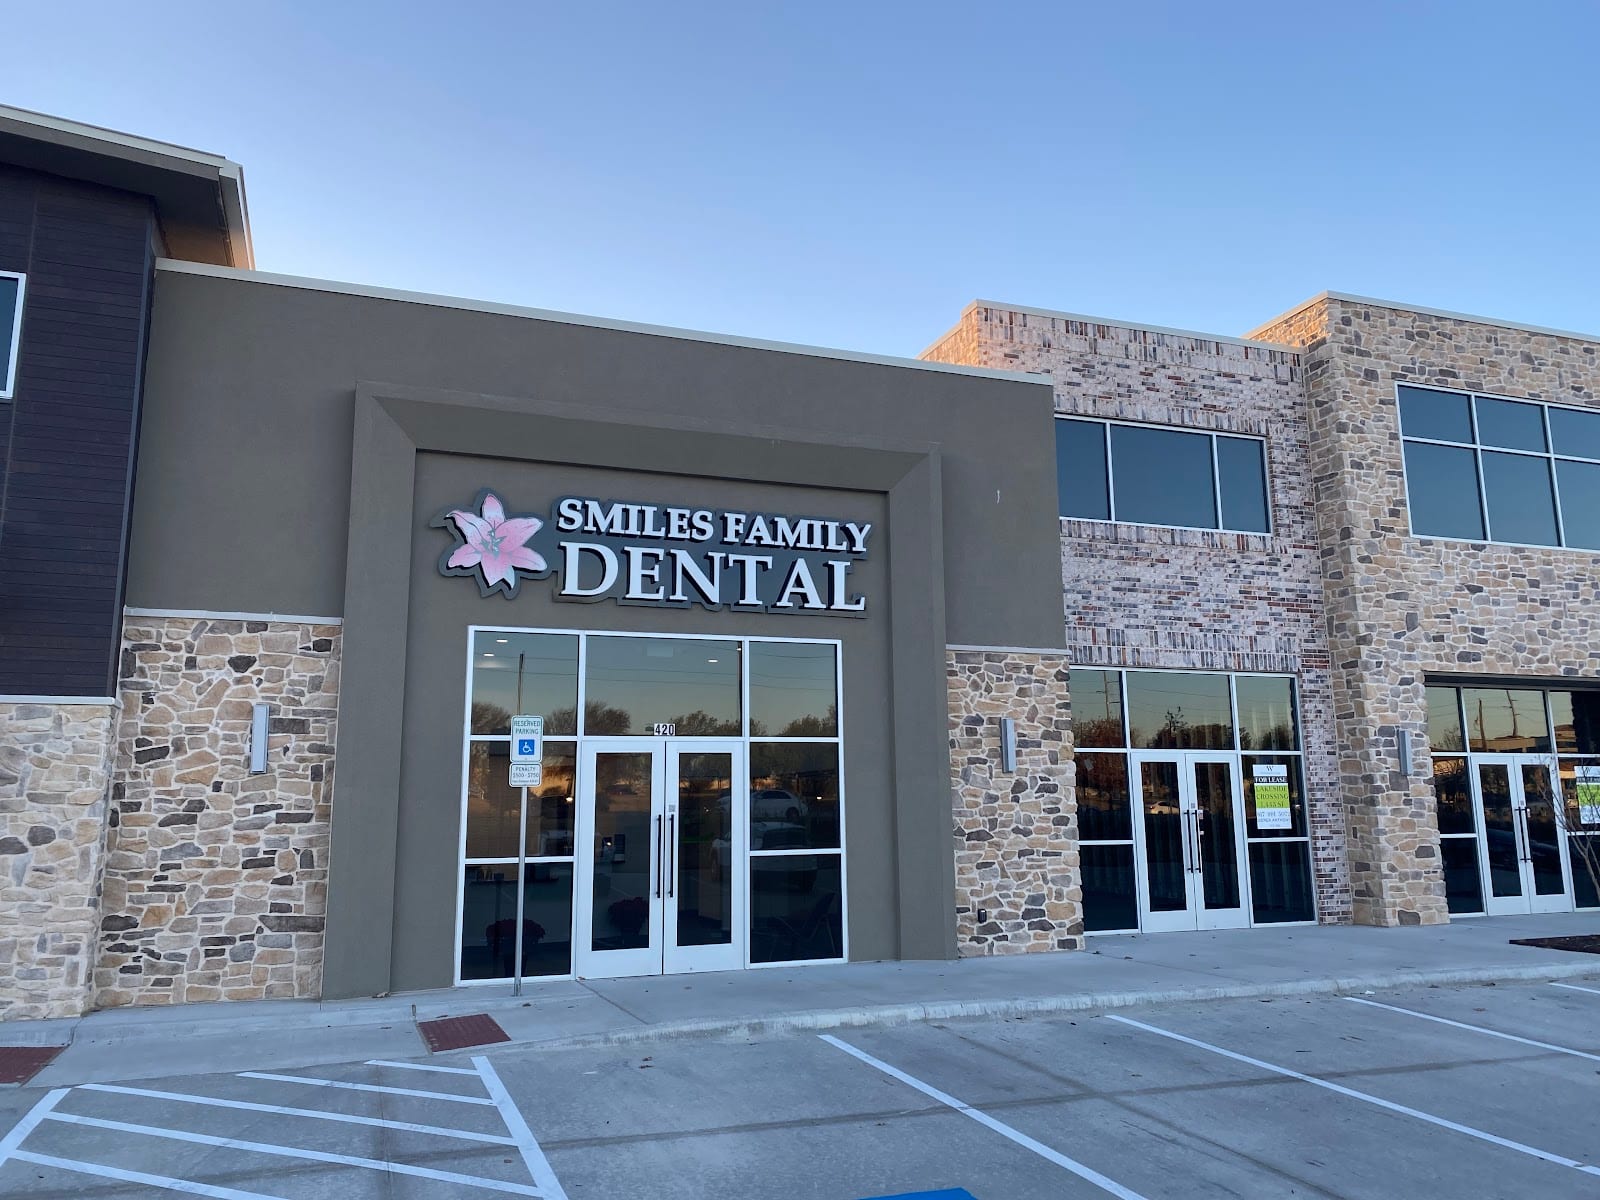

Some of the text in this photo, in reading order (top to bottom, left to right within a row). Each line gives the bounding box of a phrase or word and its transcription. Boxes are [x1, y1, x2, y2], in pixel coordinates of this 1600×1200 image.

[557, 498, 872, 553] SMILES FAMILY
[558, 540, 866, 611] DENTAL
[655, 724, 675, 736] 420
[1255, 785, 1286, 793] LAKESIDE
